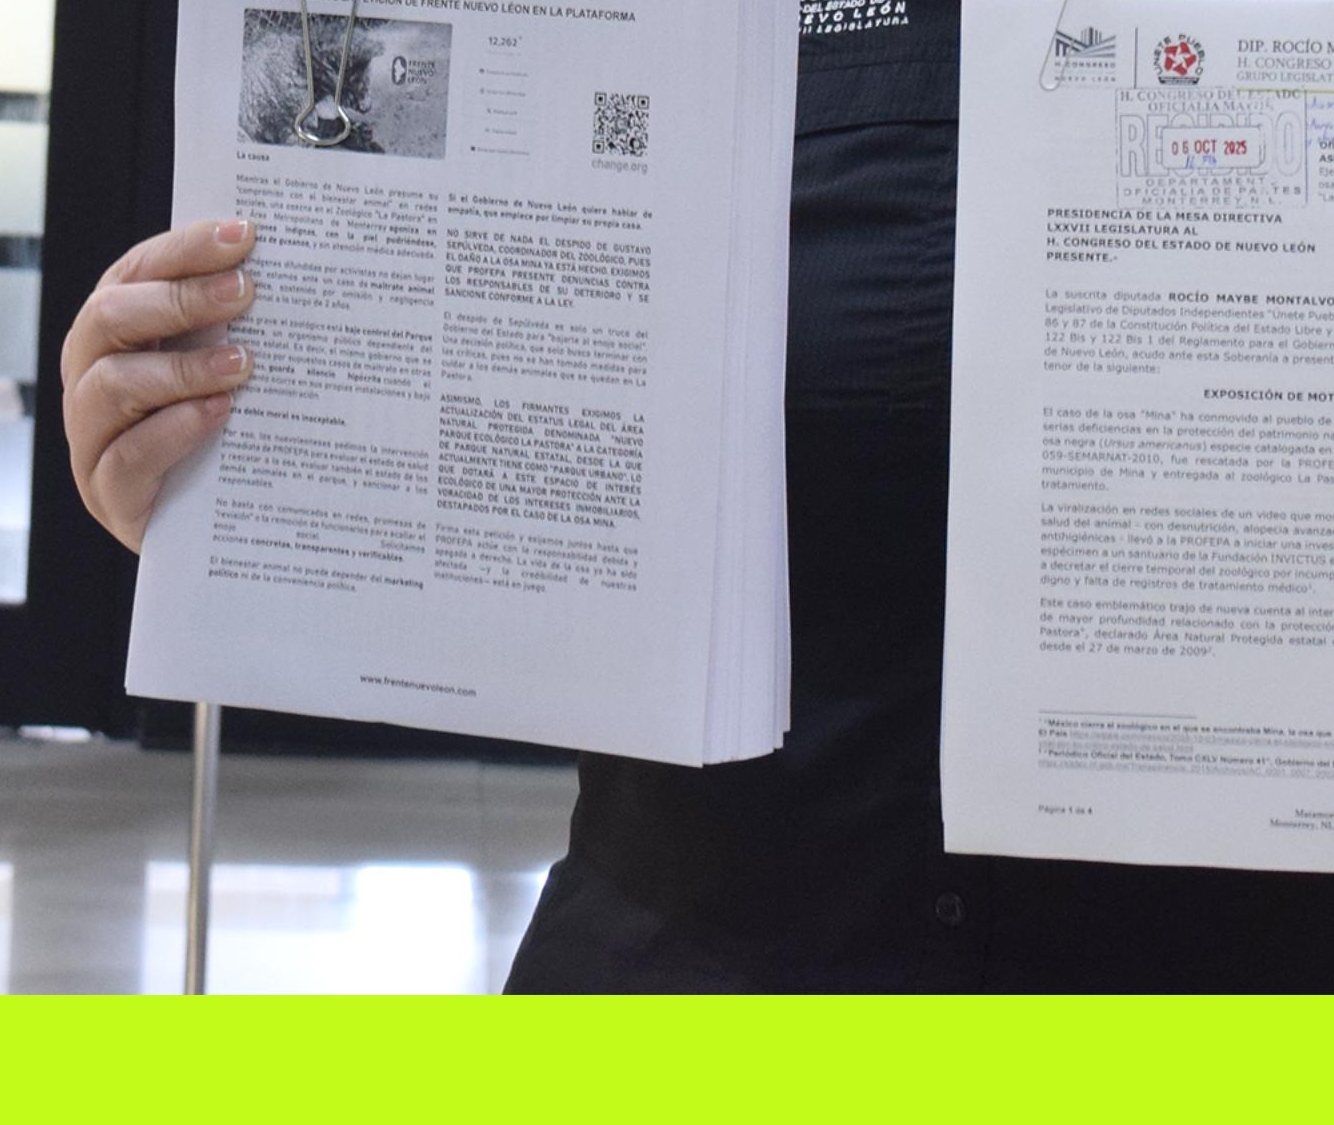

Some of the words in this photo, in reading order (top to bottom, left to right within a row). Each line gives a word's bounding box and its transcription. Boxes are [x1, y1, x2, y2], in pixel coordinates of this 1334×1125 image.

[462, 0, 500, 13] NUEVO
[500, 2, 531, 15] LÉON
[532, 4, 548, 16] EN
[549, 6, 564, 17] LA
[565, 7, 636, 22] PLATAFORMA
[853, 1, 907, 19] LEÓN
[1237, 38, 1268, 53] DIP.
[1272, 40, 1323, 54] ROCÍO
[1237, 56, 1251, 69] H.
[1254, 57, 1333, 70] CONGRESO
[1235, 70, 1278, 82] GRUPO
[1137, 90, 1215, 101] CONGRESO
[1194, 140, 1218, 154] OCT
[1223, 140, 1248, 156] 2025
[591, 157, 650, 176] change.org
[1047, 208, 1133, 220] PRESIDENCIA
[1135, 210, 1153, 221] DE
[1155, 211, 1172, 221] LA
[1175, 212, 1210, 221] MESA
[1212, 213, 1283, 224] DIRECTIVA
[1046, 222, 1091, 233] LXXVII
[1093, 223, 1180, 236] LEGISLATURA
[1183, 226, 1198, 236] AL
[446, 228, 460, 238] NO
[463, 229, 489, 241] SIRVE
[492, 232, 506, 242] DE
[509, 234, 534, 245] NADA
[538, 236, 550, 247] EL
[554, 238, 592, 250] DESPIDO
[595, 241, 608, 252] DE
[612, 243, 652, 256] GUSTAVO
[1046, 237, 1060, 246] H.
[1063, 236, 1132, 249] CONGRESO
[1134, 239, 1158, 250] DEL
[1161, 239, 1212, 251] ESTADO
[1214, 240, 1231, 252] DE
[1235, 242, 1279, 253] NUEVO
[1282, 242, 1316, 254] LEÓN
[1046, 251, 1118, 263] PRESENTE.-
[1045, 289, 1058, 298] La
[1065, 291, 1107, 300] suscrita
[1113, 291, 1162, 301] diputada
[1167, 291, 1210, 303] ROCÍO
[1215, 293, 1259, 304] MAYBE
[1203, 388, 1284, 401] EXPOSICIÓN
[1286, 391, 1304, 402] DE
